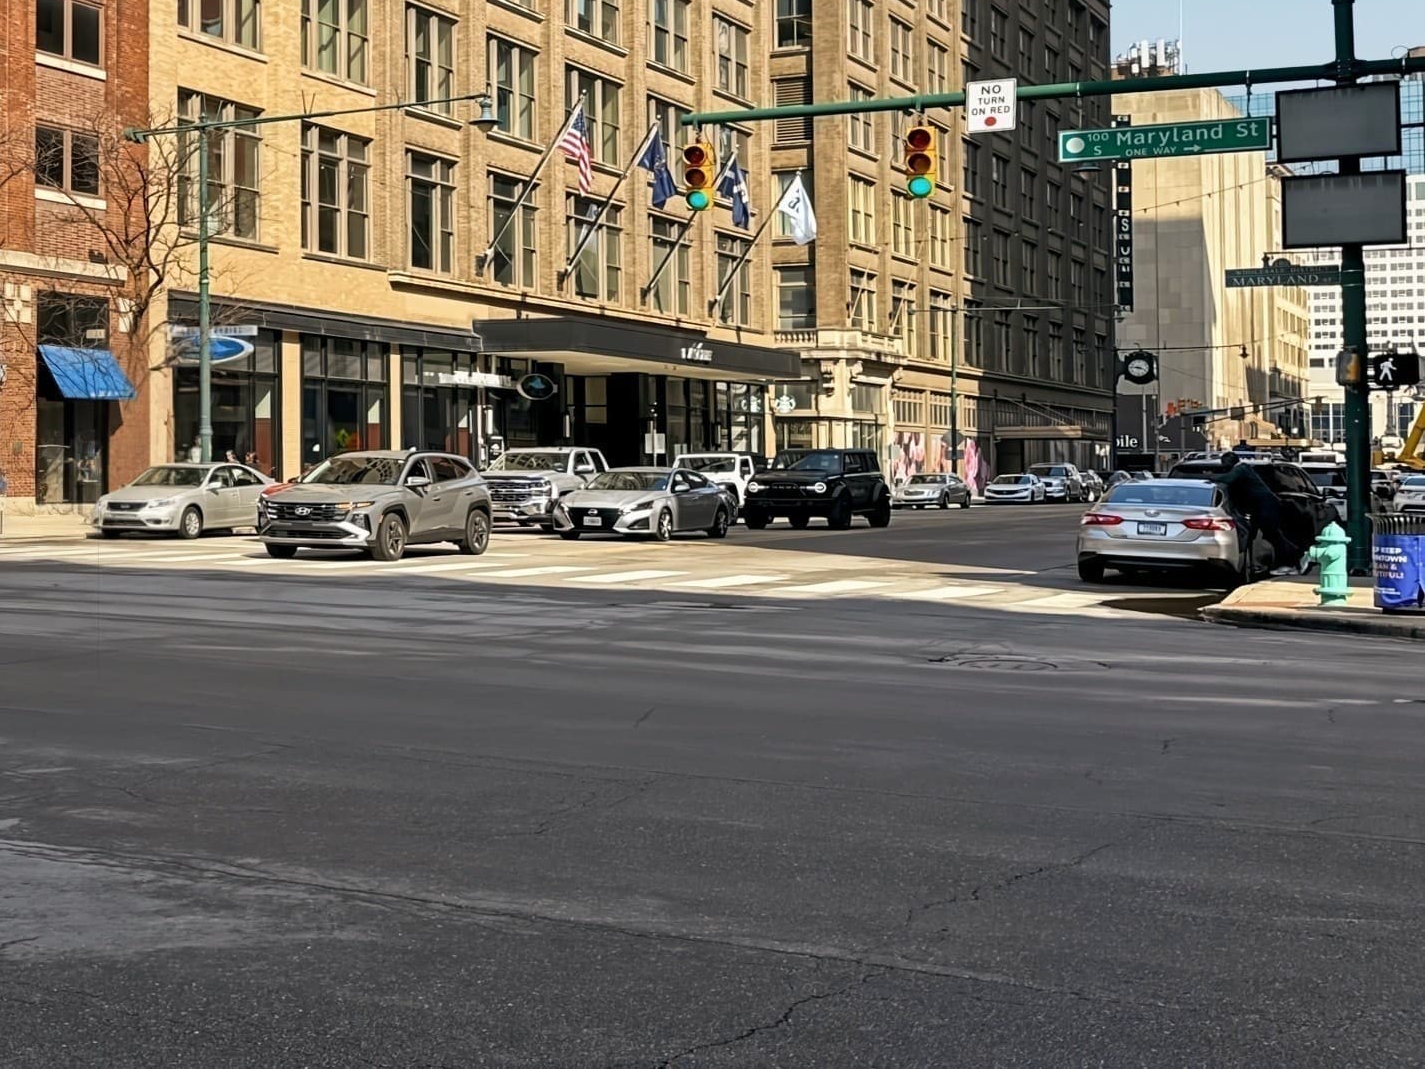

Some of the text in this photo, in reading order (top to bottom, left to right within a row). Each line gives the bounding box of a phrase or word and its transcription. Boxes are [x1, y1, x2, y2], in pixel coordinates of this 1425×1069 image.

[981, 84, 1001, 95] NO
[978, 95, 1005, 105] TURN
[971, 105, 1011, 116] ON RED
[1087, 132, 1109, 142] 100
[1116, 122, 1259, 148] Maryland St
[1093, 145, 1102, 156] S
[1125, 146, 1177, 157] ONE WAY
[1232, 274, 1319, 286] MARYLAND
